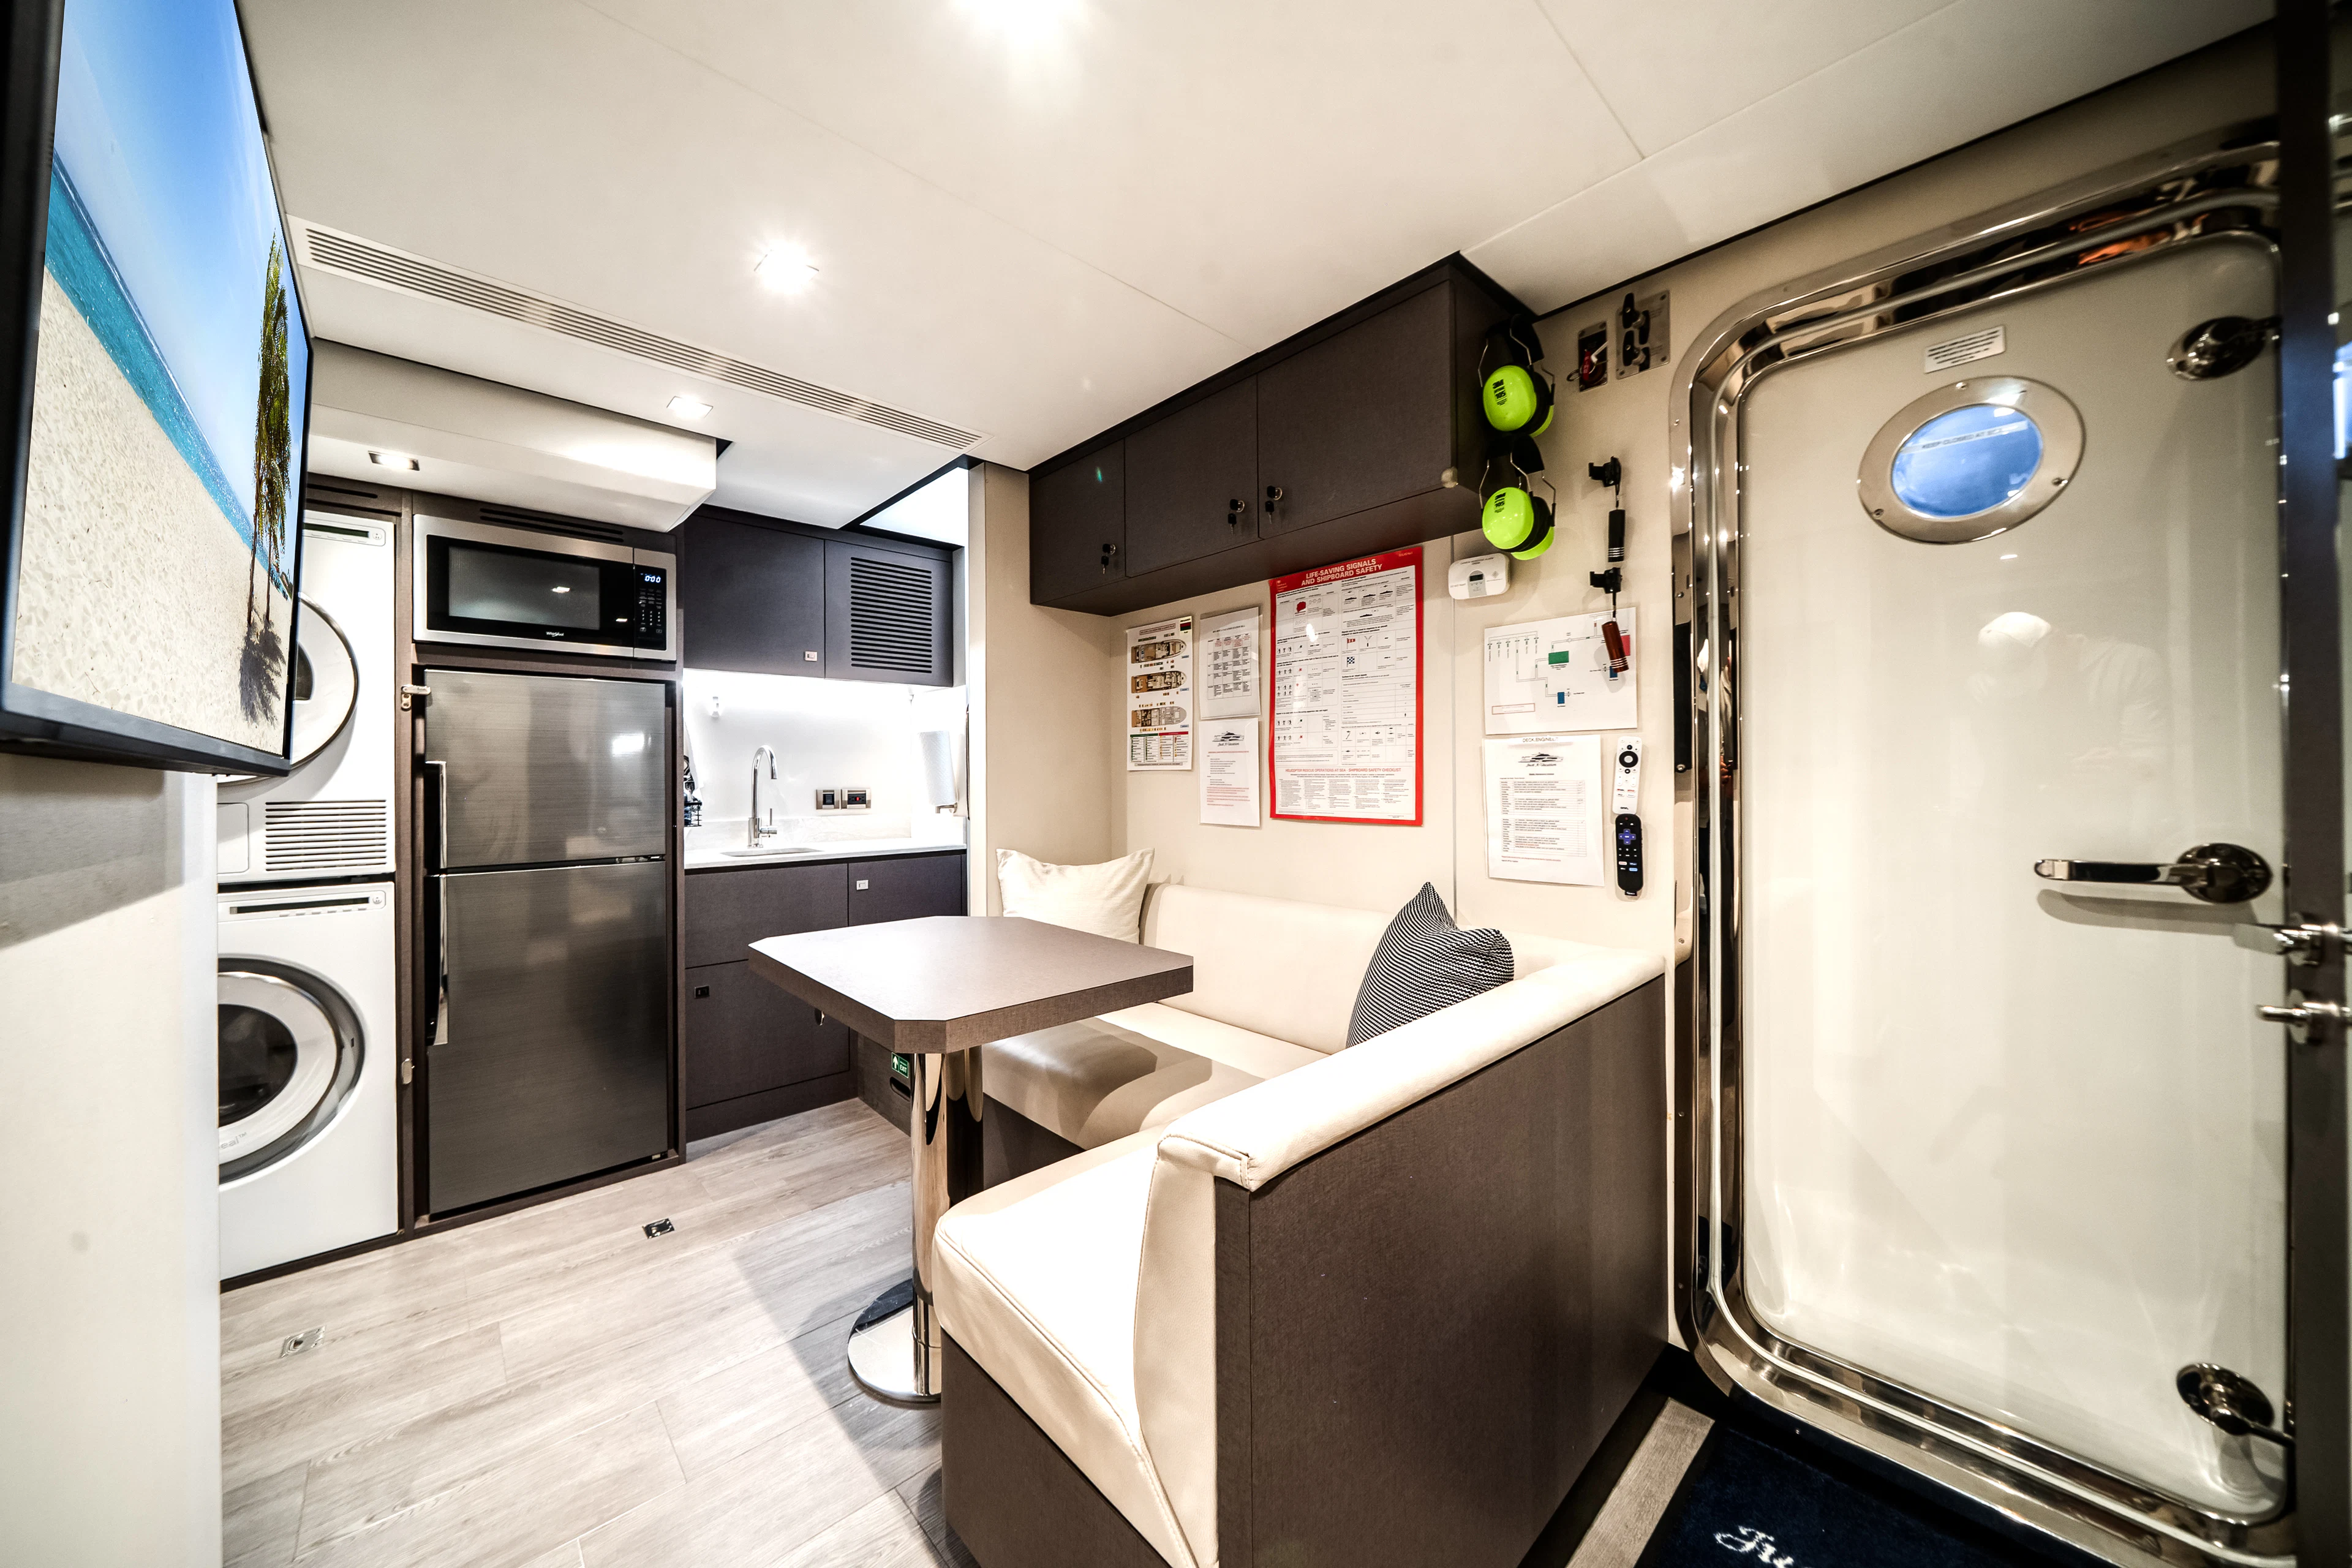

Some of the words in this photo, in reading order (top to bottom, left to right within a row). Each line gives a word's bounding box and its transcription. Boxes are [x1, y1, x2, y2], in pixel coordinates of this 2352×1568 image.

[1492, 379, 1504, 389] 3M
[1301, 578, 1315, 586] AND
[1316, 570, 1354, 582] SHIPBOARD
[1355, 564, 1382, 575] SAFETY
[1306, 565, 1344, 579] LIFE-SAVING
[1346, 559, 1376, 570] SIGNALS
